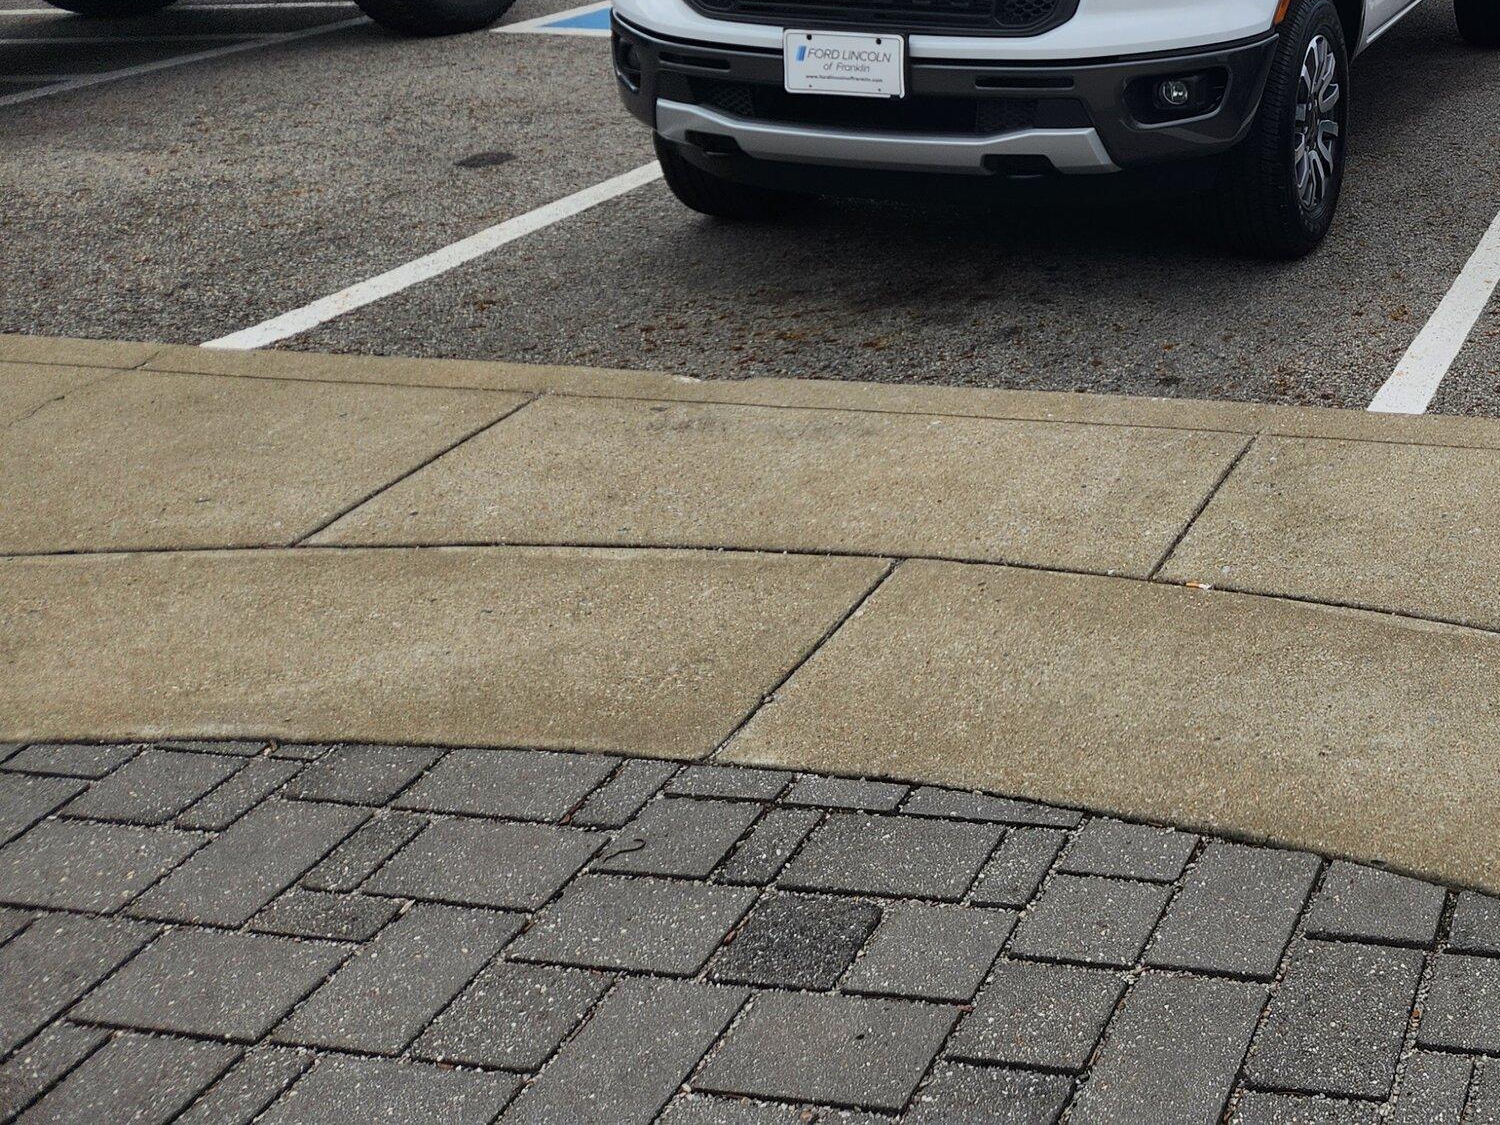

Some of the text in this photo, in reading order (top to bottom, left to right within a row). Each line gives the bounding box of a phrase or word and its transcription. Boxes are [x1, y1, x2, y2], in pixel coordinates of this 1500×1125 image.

[808, 48, 891, 63] FORD LINCOLN
[823, 61, 870, 73] of Franklin
